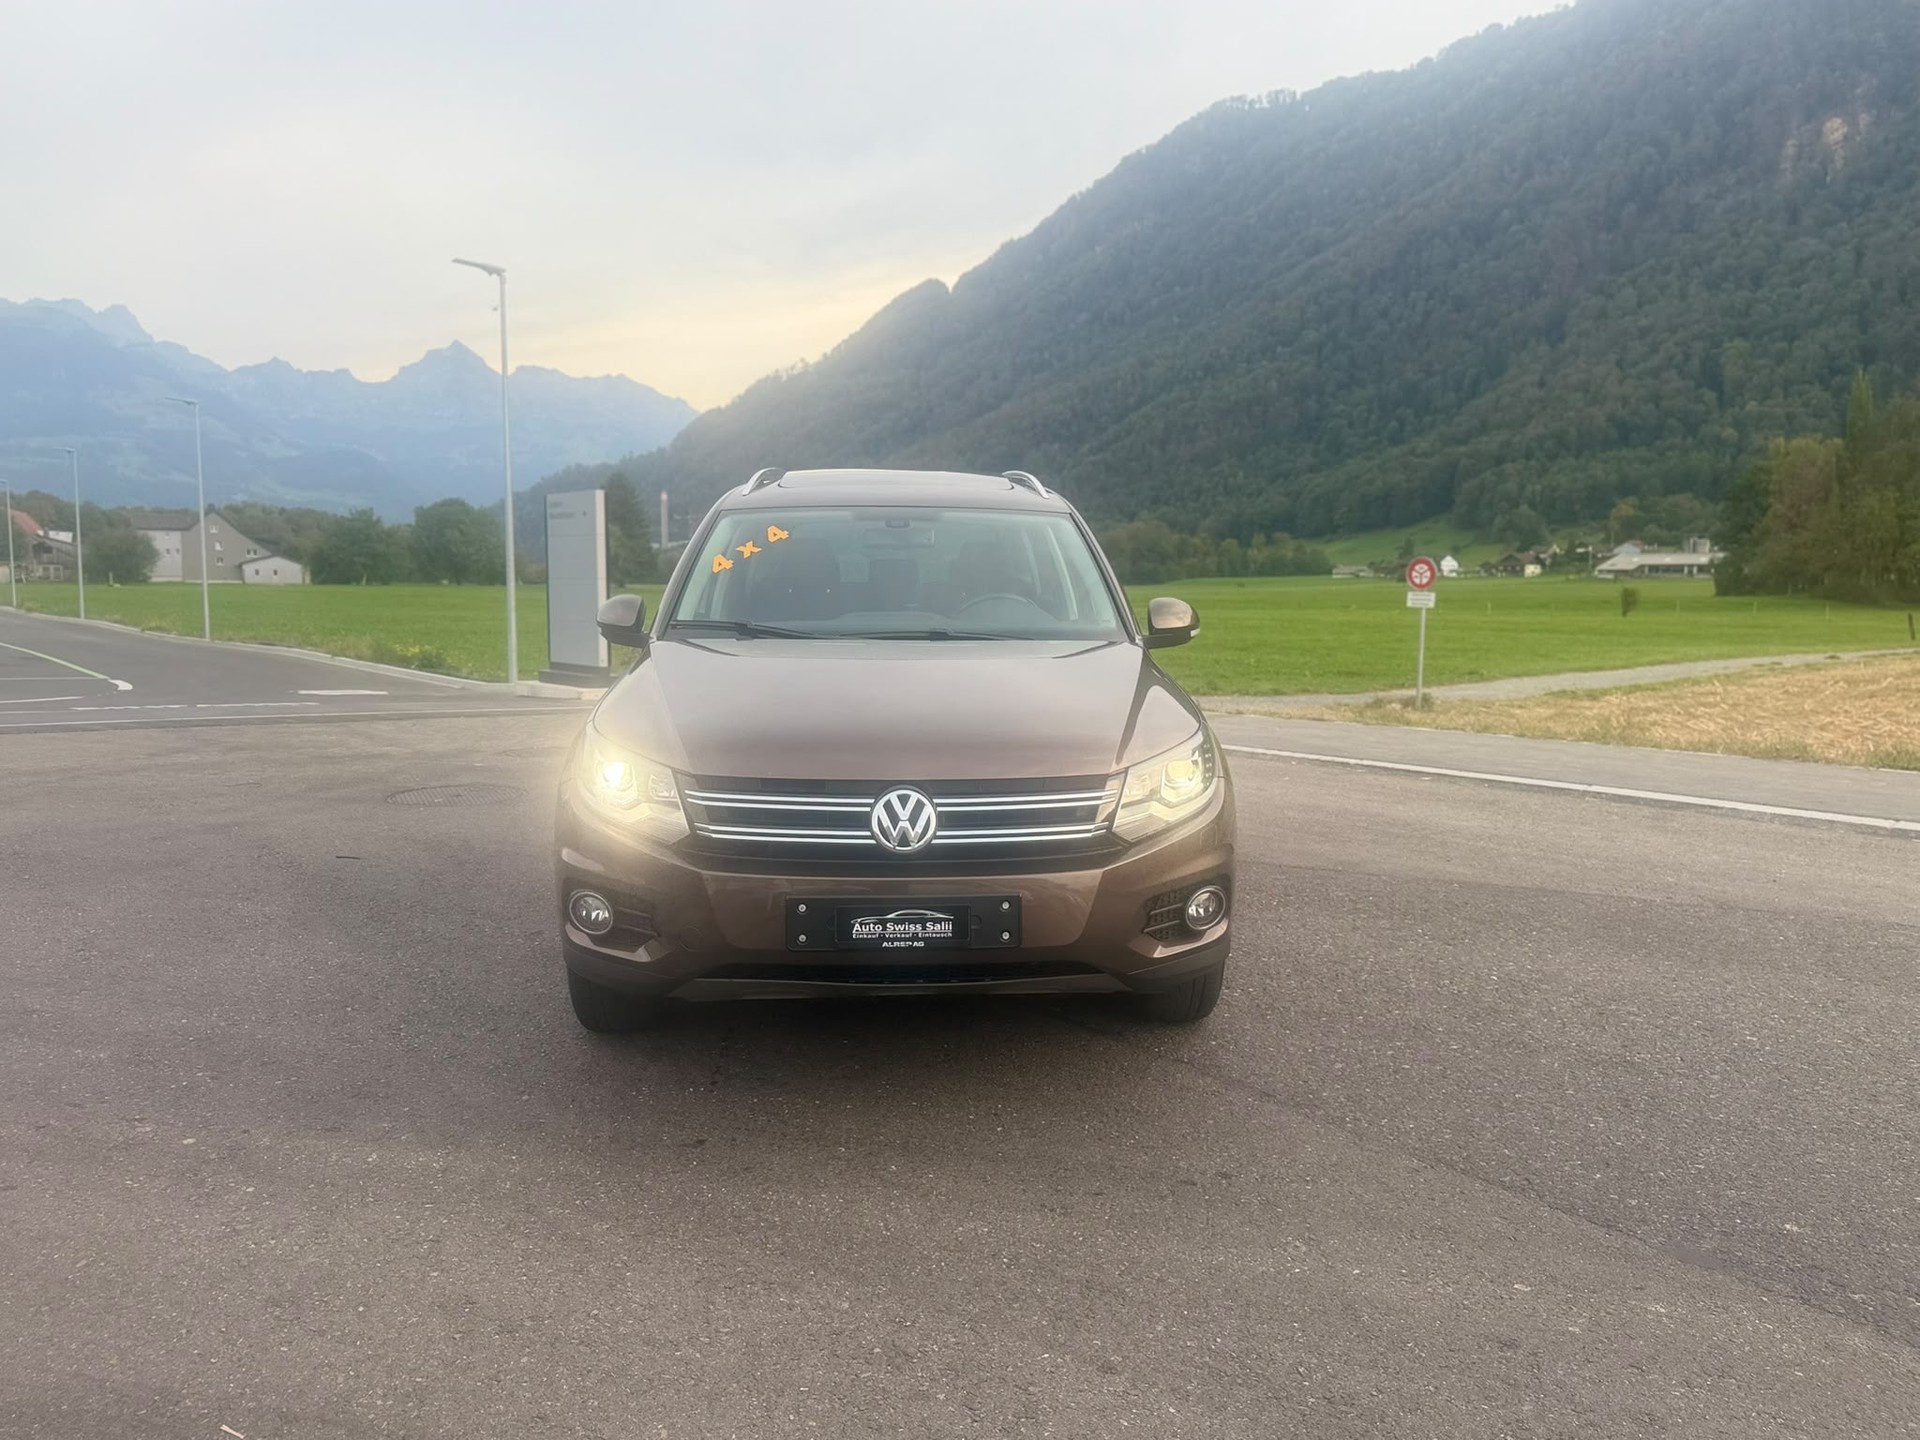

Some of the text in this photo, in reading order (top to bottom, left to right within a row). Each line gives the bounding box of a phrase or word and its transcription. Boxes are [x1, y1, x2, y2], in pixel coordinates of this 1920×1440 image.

[712, 553, 734, 574] 4
[767, 525, 790, 543] 4
[873, 790, 935, 850] VW
[852, 923, 883, 933] Auto
[886, 922, 923, 931] Swiss
